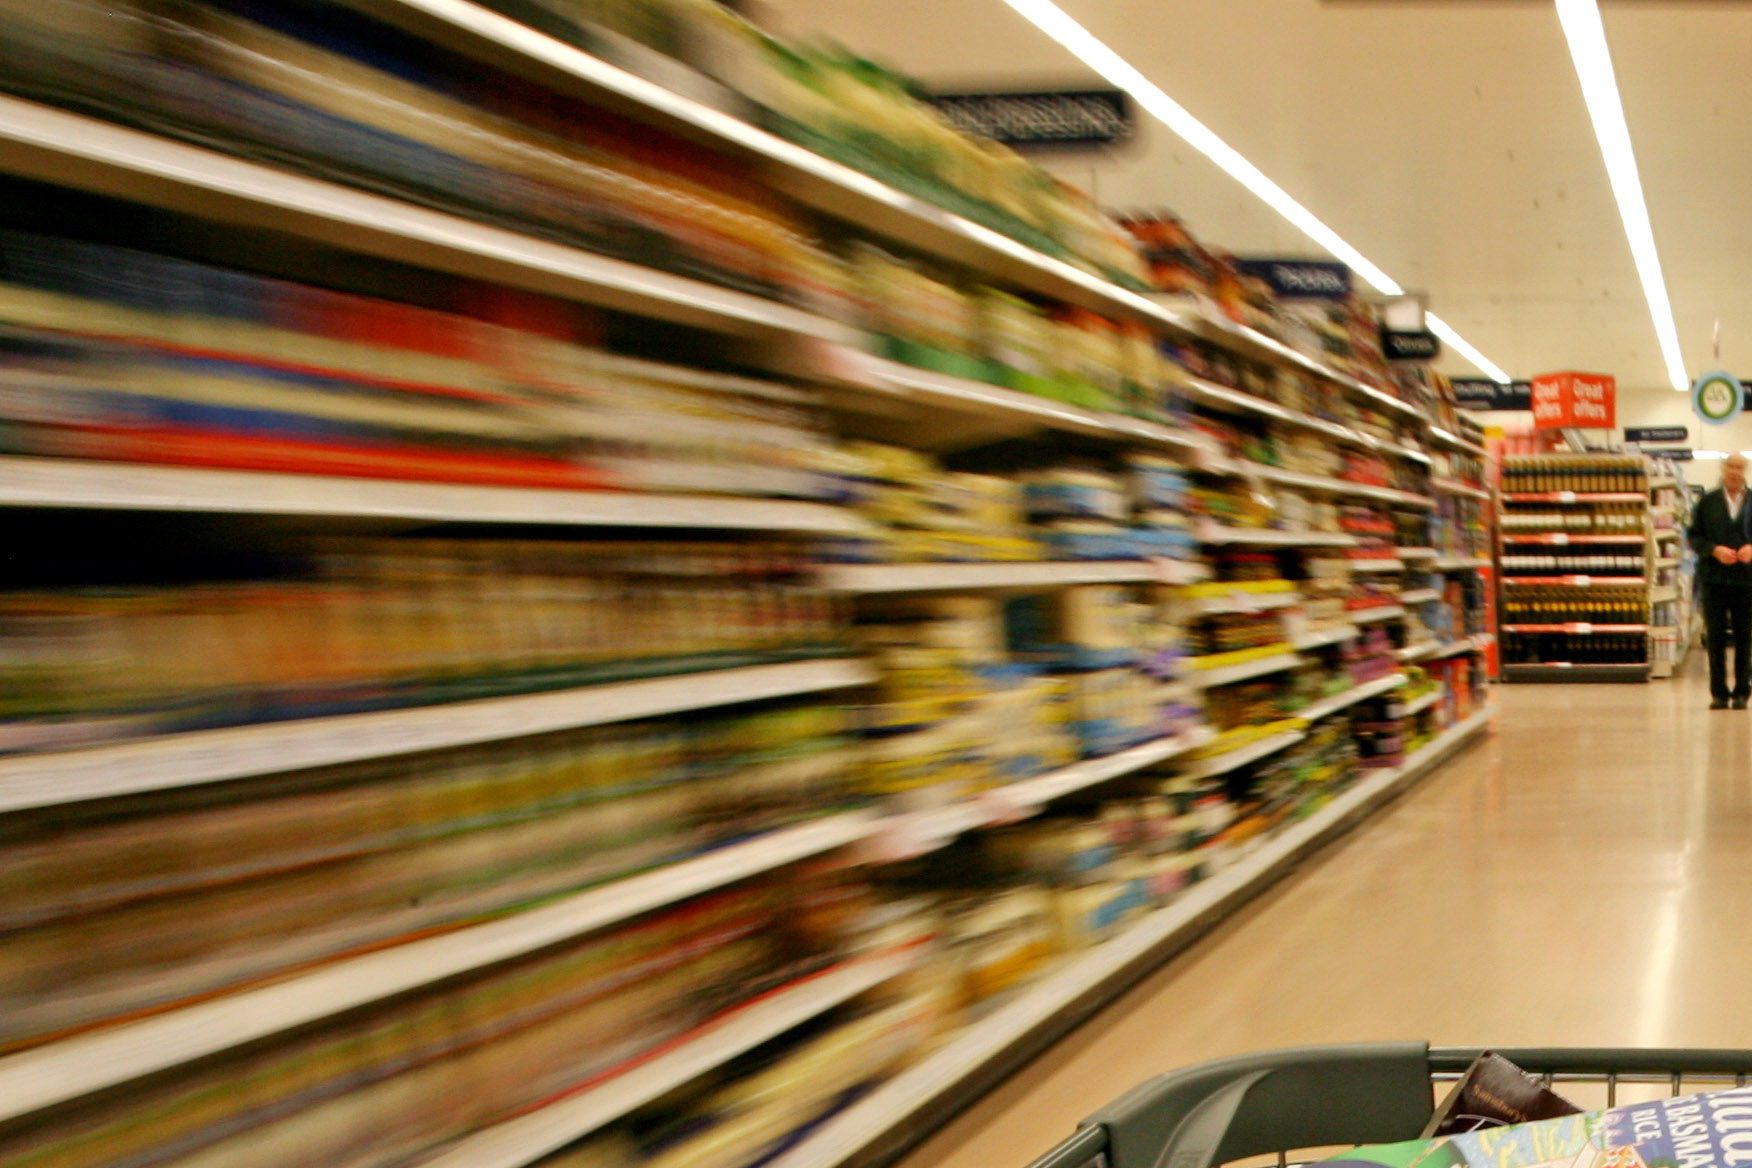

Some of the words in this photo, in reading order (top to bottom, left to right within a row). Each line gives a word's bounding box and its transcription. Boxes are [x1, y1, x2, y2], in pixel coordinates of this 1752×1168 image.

[1573, 379, 1604, 400] Great
[1573, 400, 1606, 420] offers
[1631, 1108, 1662, 1144] RICE
